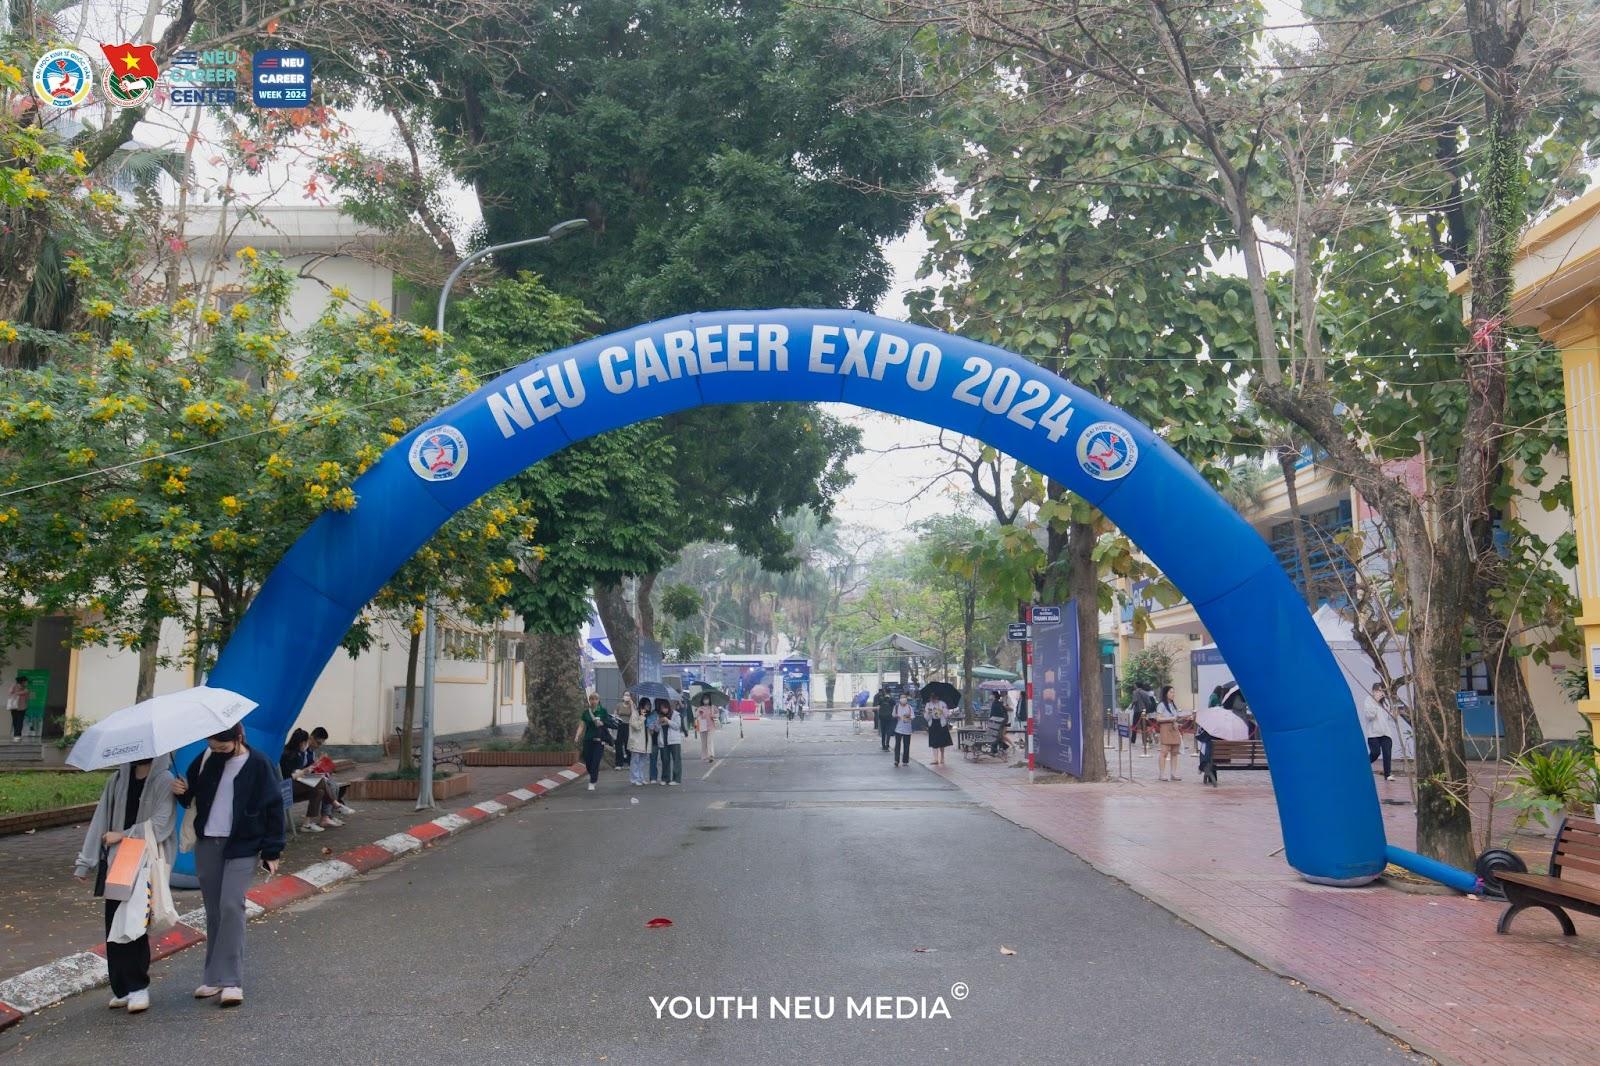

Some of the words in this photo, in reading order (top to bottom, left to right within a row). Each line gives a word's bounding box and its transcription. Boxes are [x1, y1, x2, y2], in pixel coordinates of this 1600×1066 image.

[486, 358, 586, 439] NEU
[598, 323, 789, 395] CAREER
[808, 324, 942, 392] EXPO
[952, 356, 1075, 443] 2024
